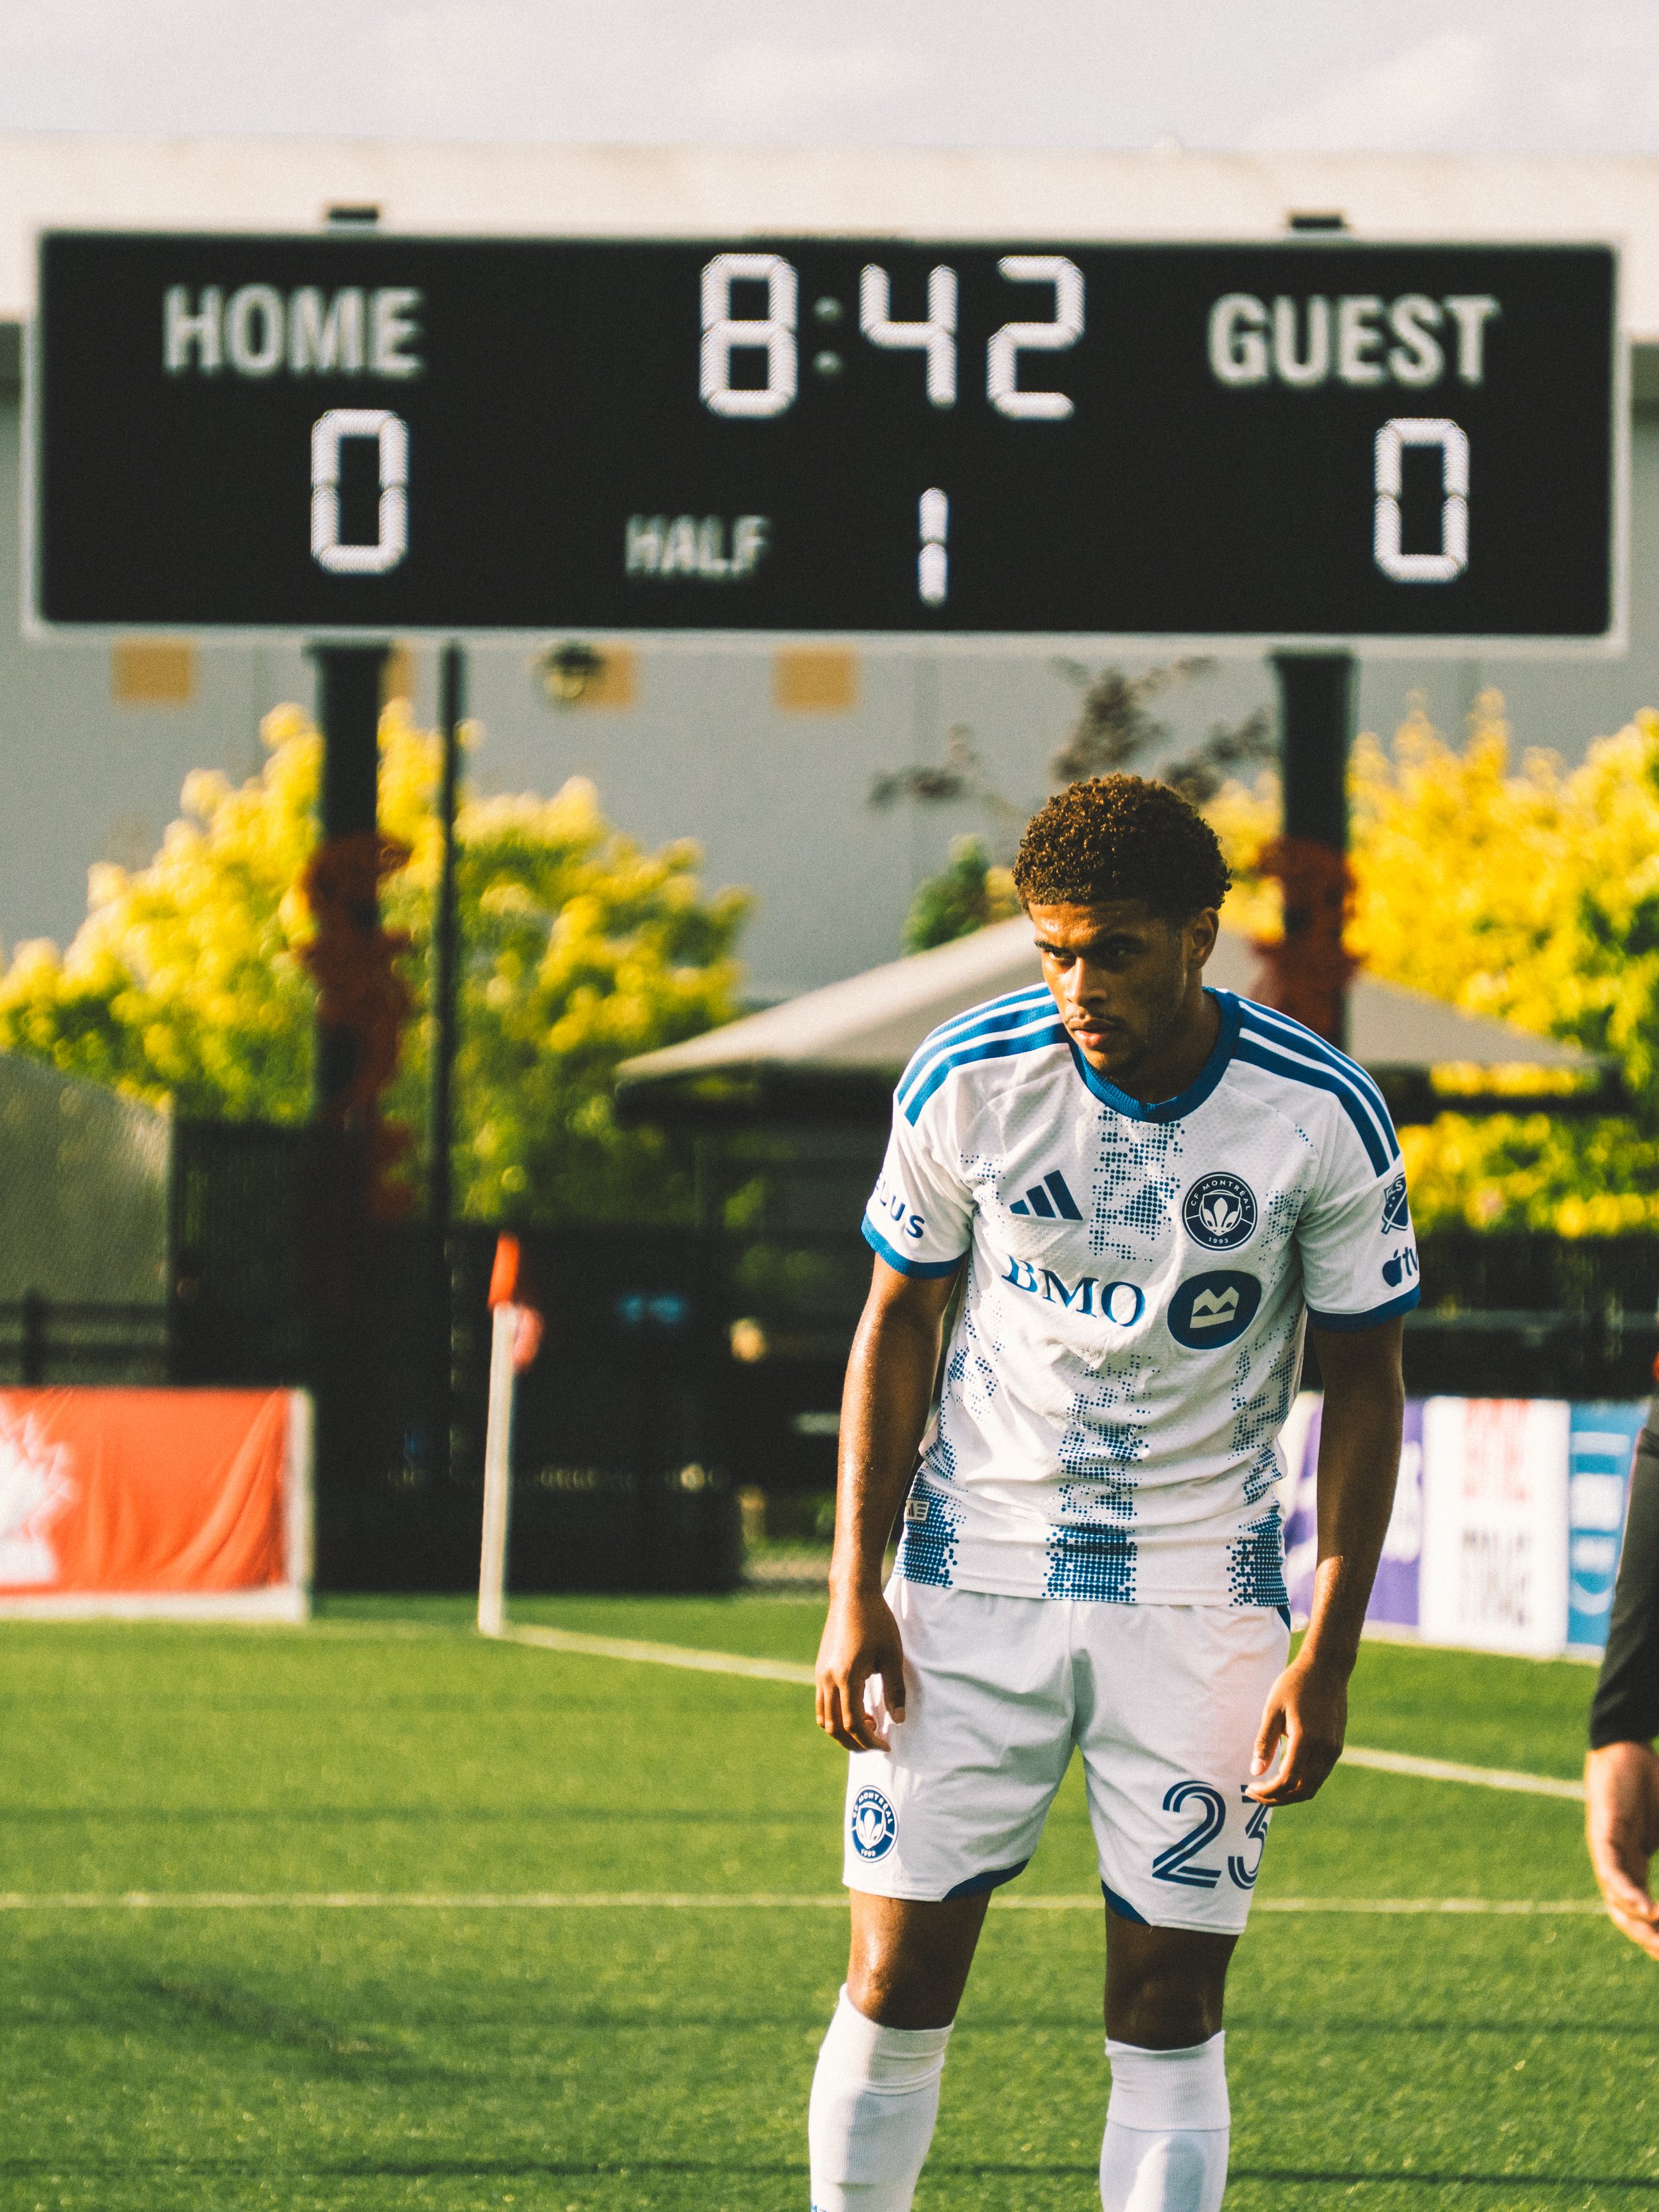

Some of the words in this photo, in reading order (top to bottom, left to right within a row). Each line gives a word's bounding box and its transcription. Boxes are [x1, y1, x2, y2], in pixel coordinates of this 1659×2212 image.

[164, 284, 423, 378] HOME
[699, 253, 1084, 419] 8:42
[1208, 292, 1500, 387] GUEST
[311, 408, 408, 573] 0
[1374, 417, 1469, 582] 0
[626, 514, 768, 579] HALF
[918, 487, 948, 604] 1
[875, 1171, 925, 1238] LUS
[1190, 1193, 1199, 1207] CF
[1202, 1180, 1251, 1211] MONTRÉAL
[1001, 1254, 1147, 1327] BMO
